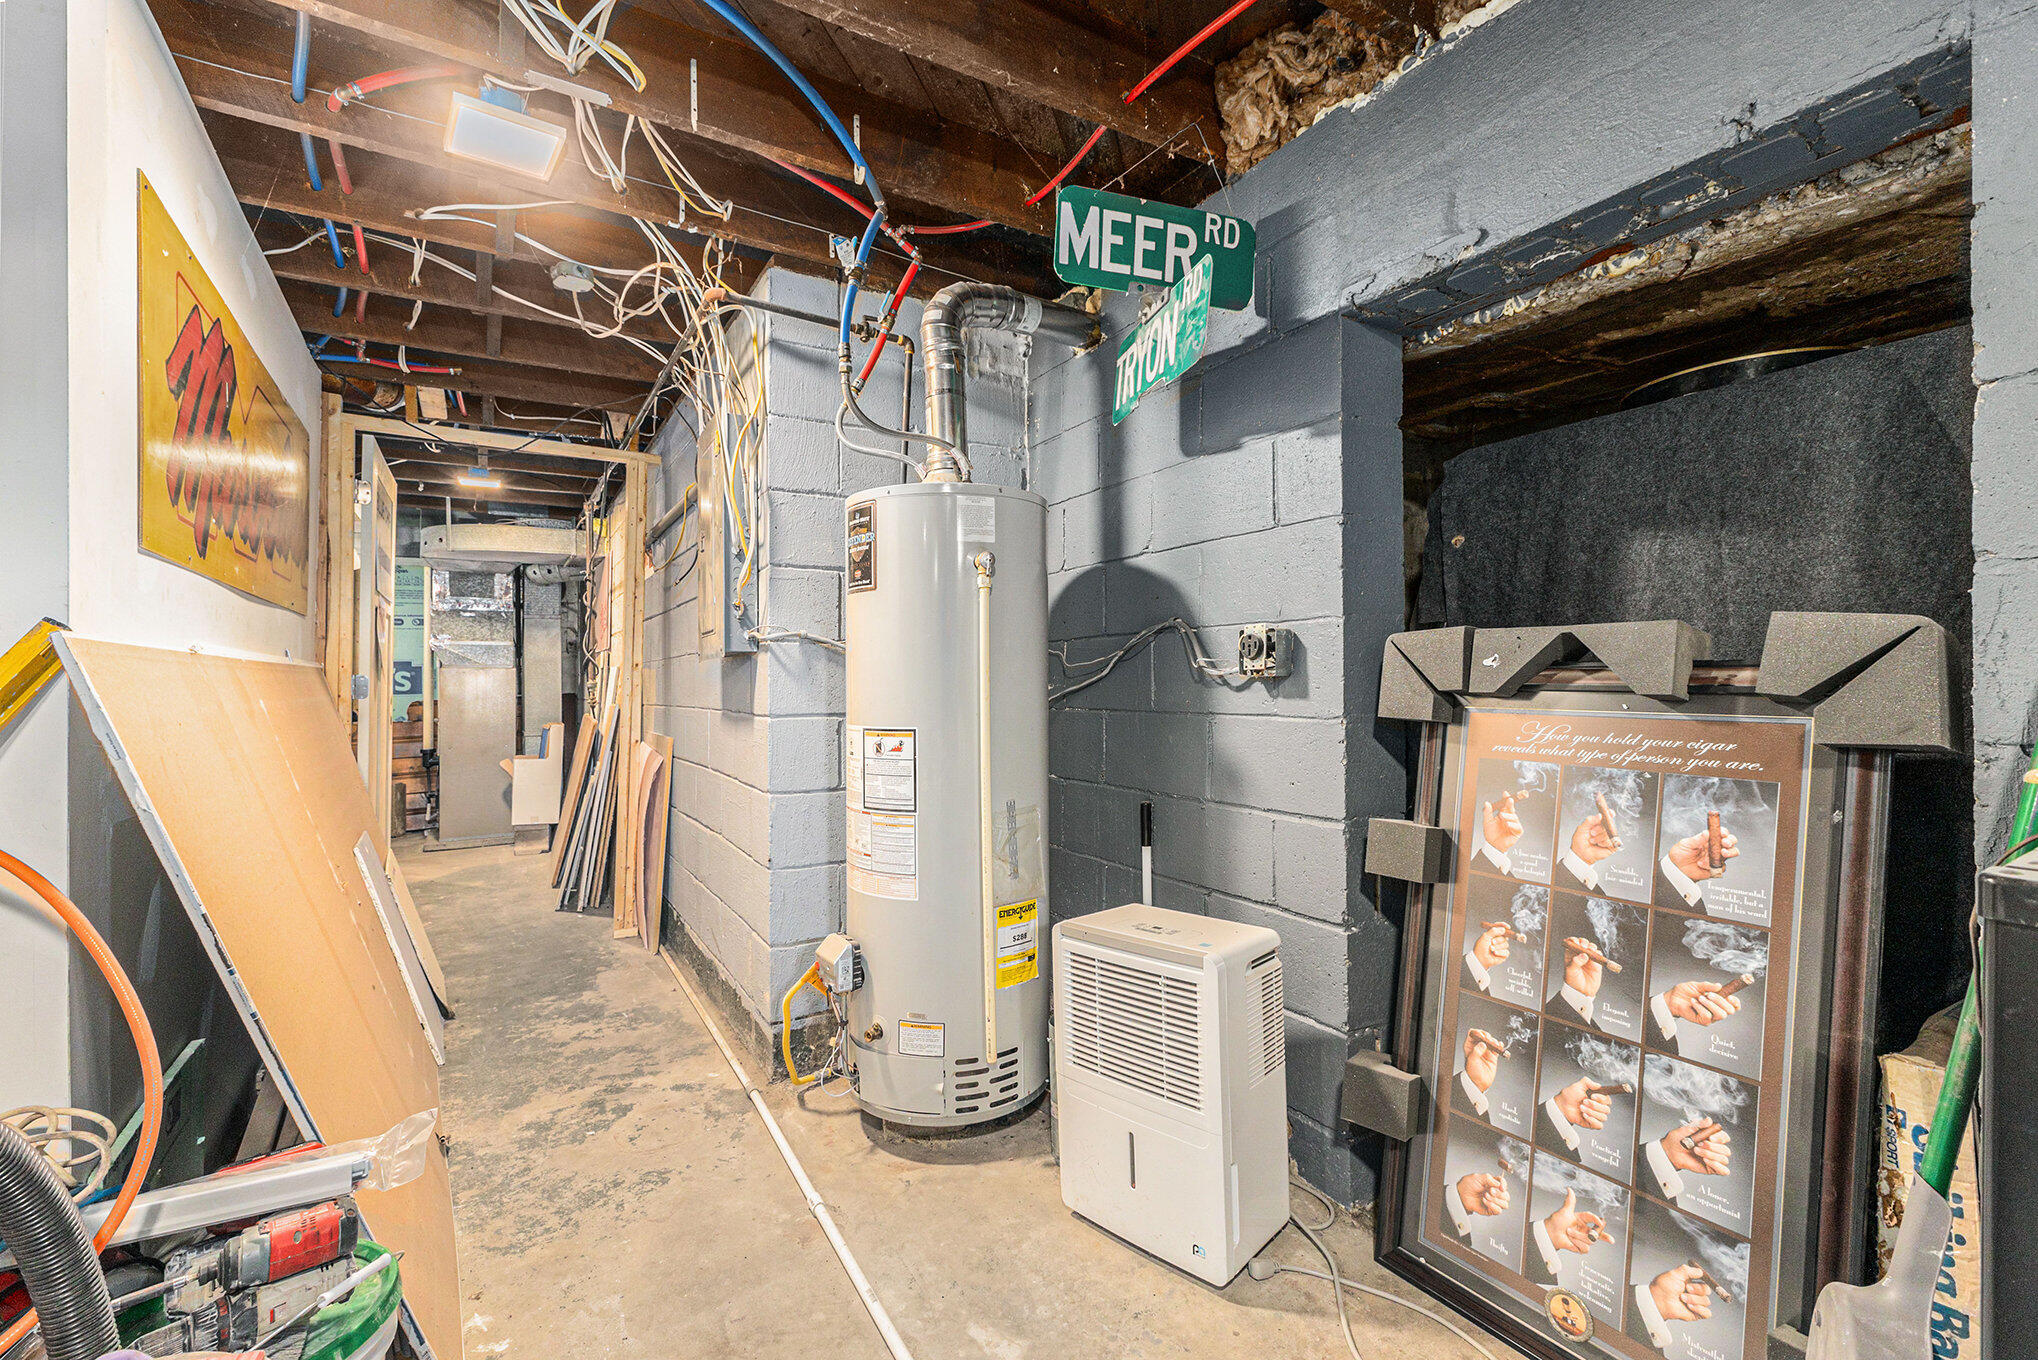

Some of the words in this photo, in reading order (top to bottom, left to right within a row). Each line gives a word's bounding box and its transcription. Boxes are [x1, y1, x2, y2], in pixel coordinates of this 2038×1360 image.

[1058, 200, 1198, 283] MEER
[1204, 212, 1241, 249] RD
[1115, 301, 1179, 411] TRYON
[1181, 266, 1204, 309] RD
[1491, 743, 1536, 755] reveals
[1538, 744, 1575, 758] what
[1576, 748, 1607, 763] type
[1610, 750, 1630, 764] of
[1625, 751, 1684, 766] person
[1686, 757, 1722, 771] you
[1725, 759, 1764, 772] are.
[1516, 720, 1571, 744] How
[1571, 733, 1600, 746] you
[1603, 732, 1639, 744] hold
[1637, 737, 1684, 752] your
[1686, 740, 1738, 757] cigar
[1885, 1127, 1900, 1169] SPORT
